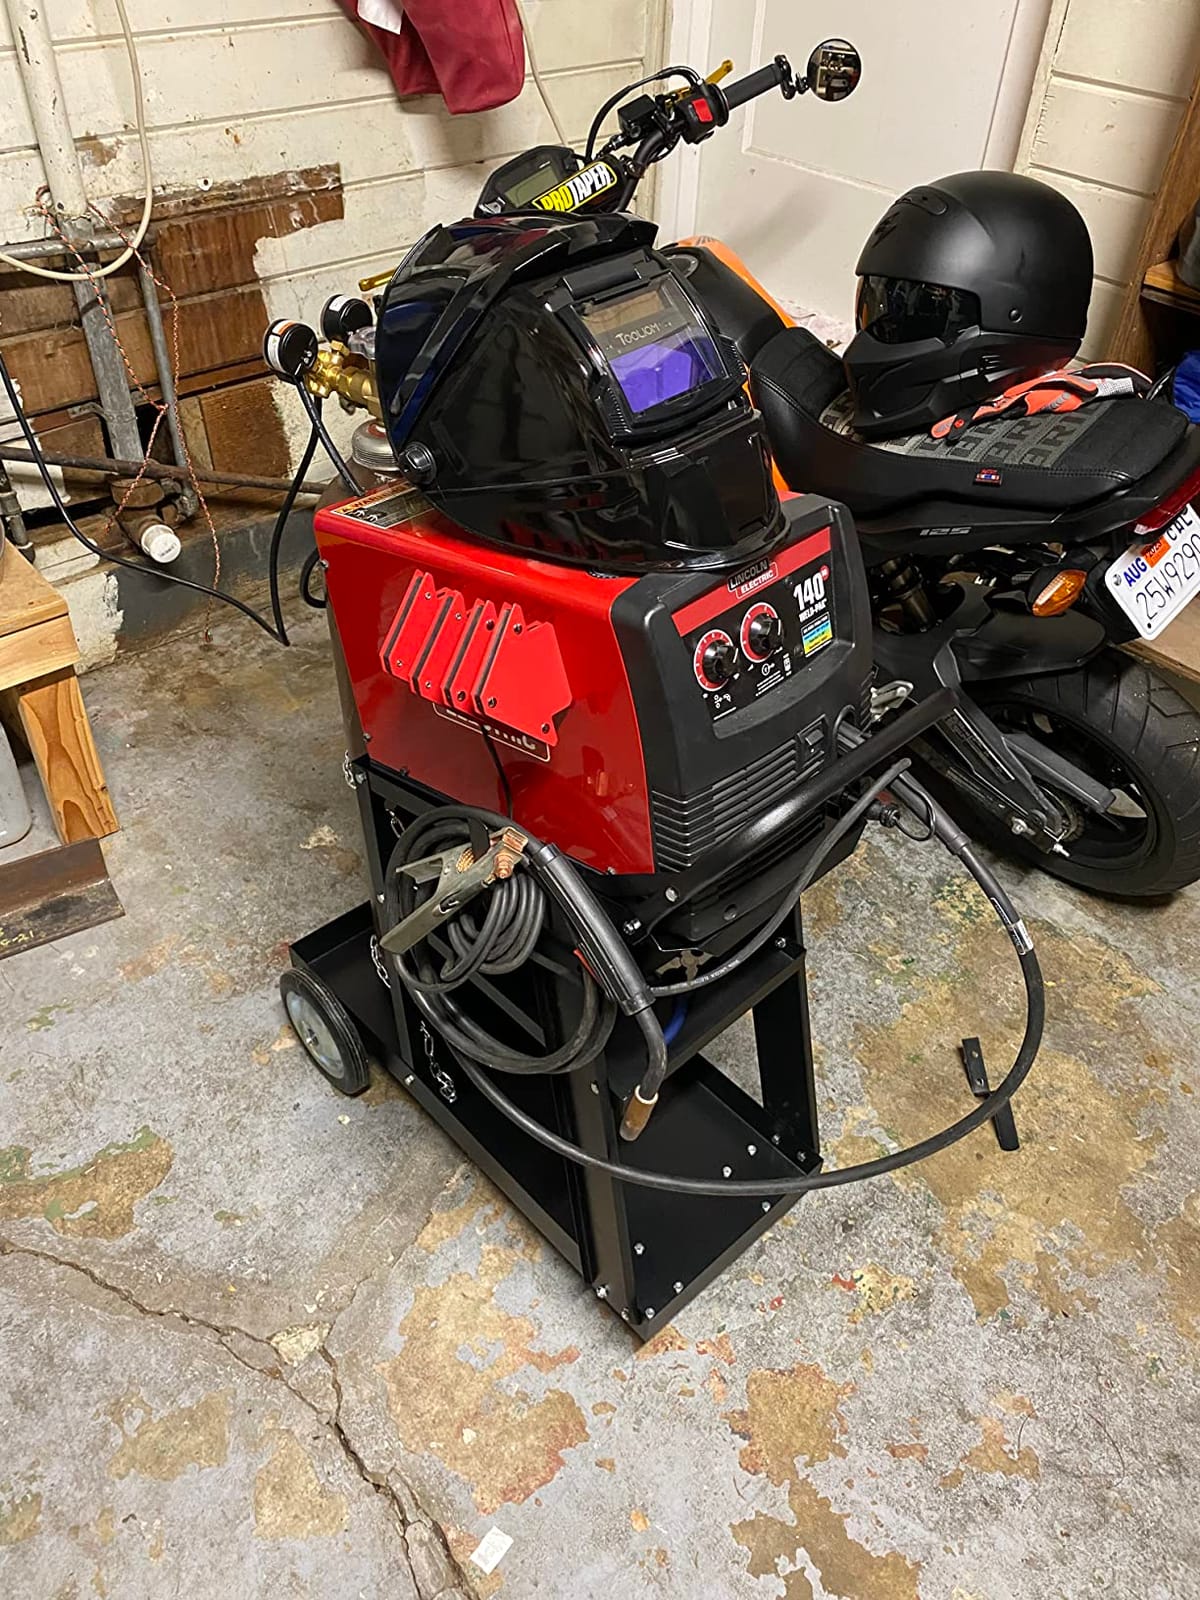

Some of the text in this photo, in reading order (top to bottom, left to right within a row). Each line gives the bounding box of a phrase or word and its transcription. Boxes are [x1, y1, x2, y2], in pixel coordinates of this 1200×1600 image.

[541, 163, 613, 212] PROTAPER
[920, 527, 972, 537] 125
[729, 558, 769, 588] LINCOLN
[740, 570, 775, 594] ELECTRIC
[1123, 557, 1148, 587] AUG
[792, 576, 825, 610] 140
